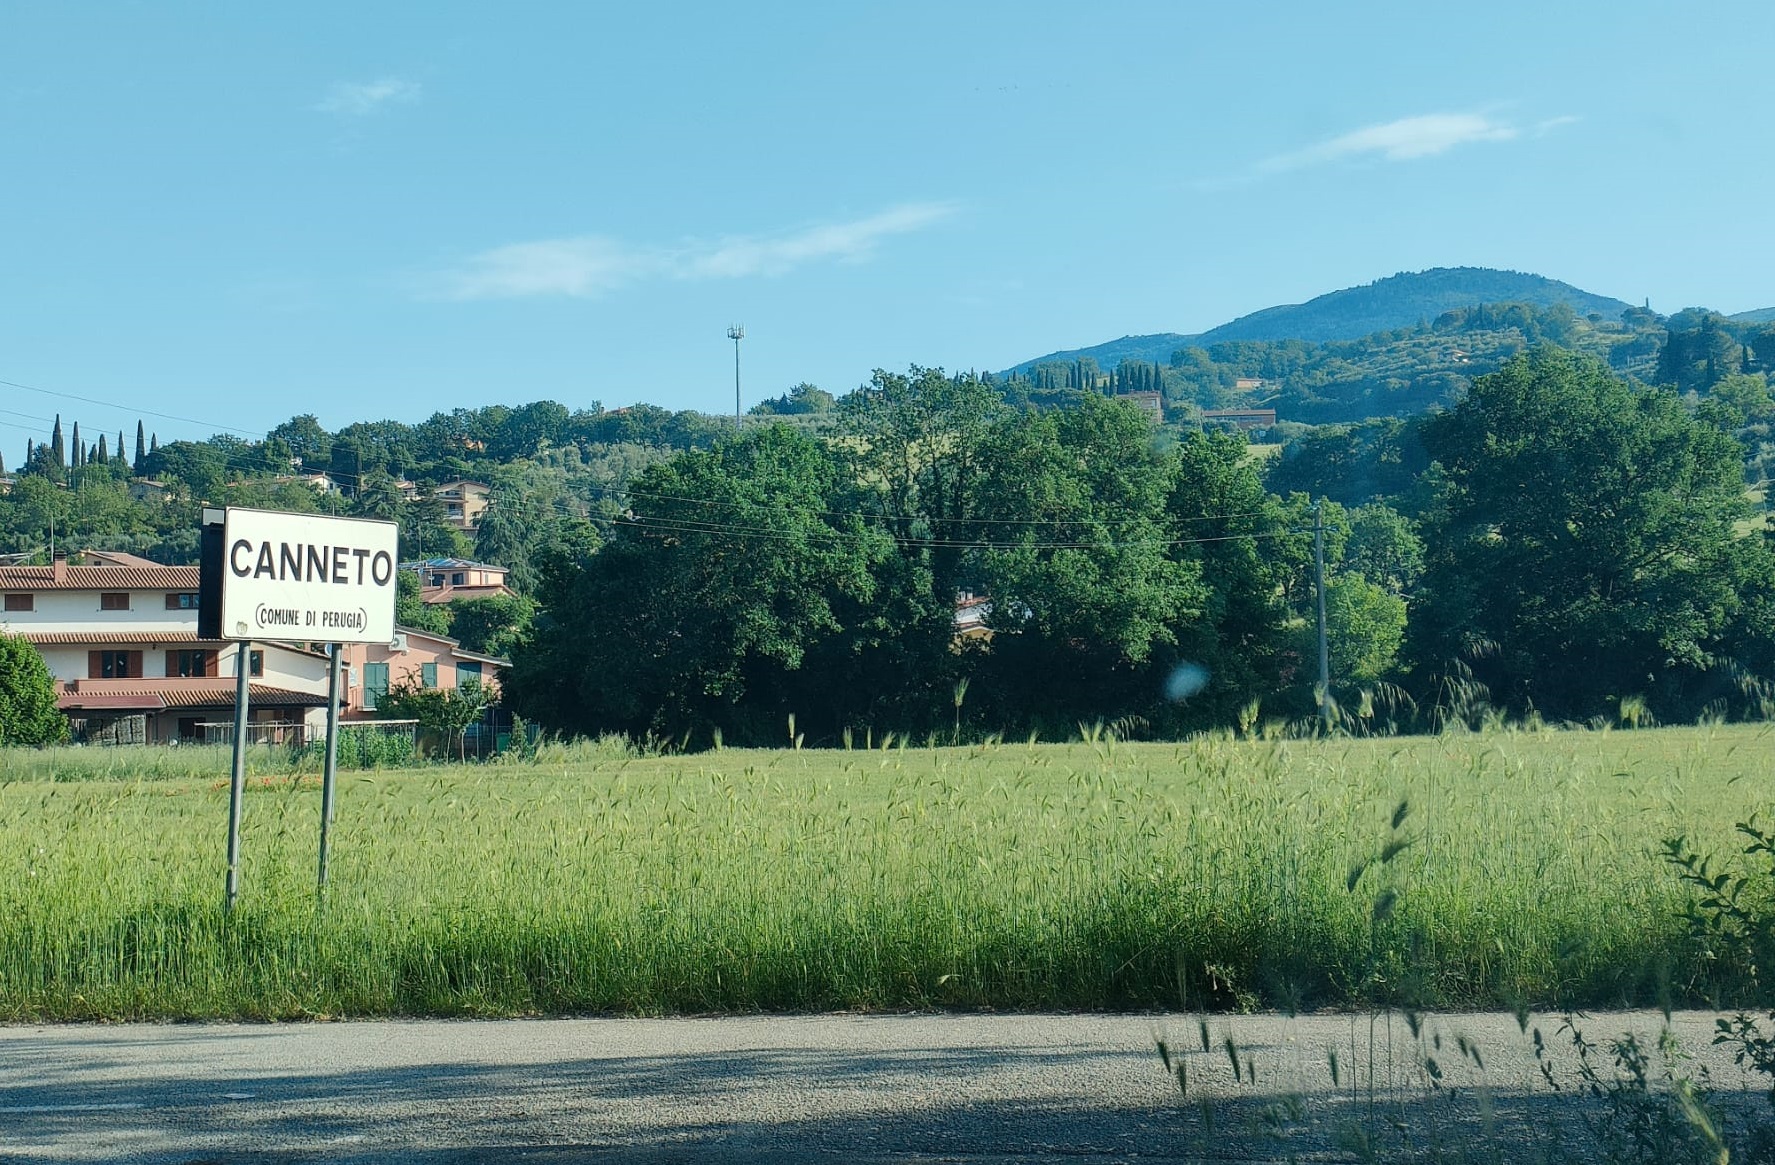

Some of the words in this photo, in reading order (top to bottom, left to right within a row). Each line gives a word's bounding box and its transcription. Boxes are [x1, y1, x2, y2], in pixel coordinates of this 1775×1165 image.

[231, 538, 392, 587] CANNETO
[255, 602, 300, 629] (COMUNE
[305, 610, 316, 626] DI
[322, 607, 367, 633] PERUGIA)
